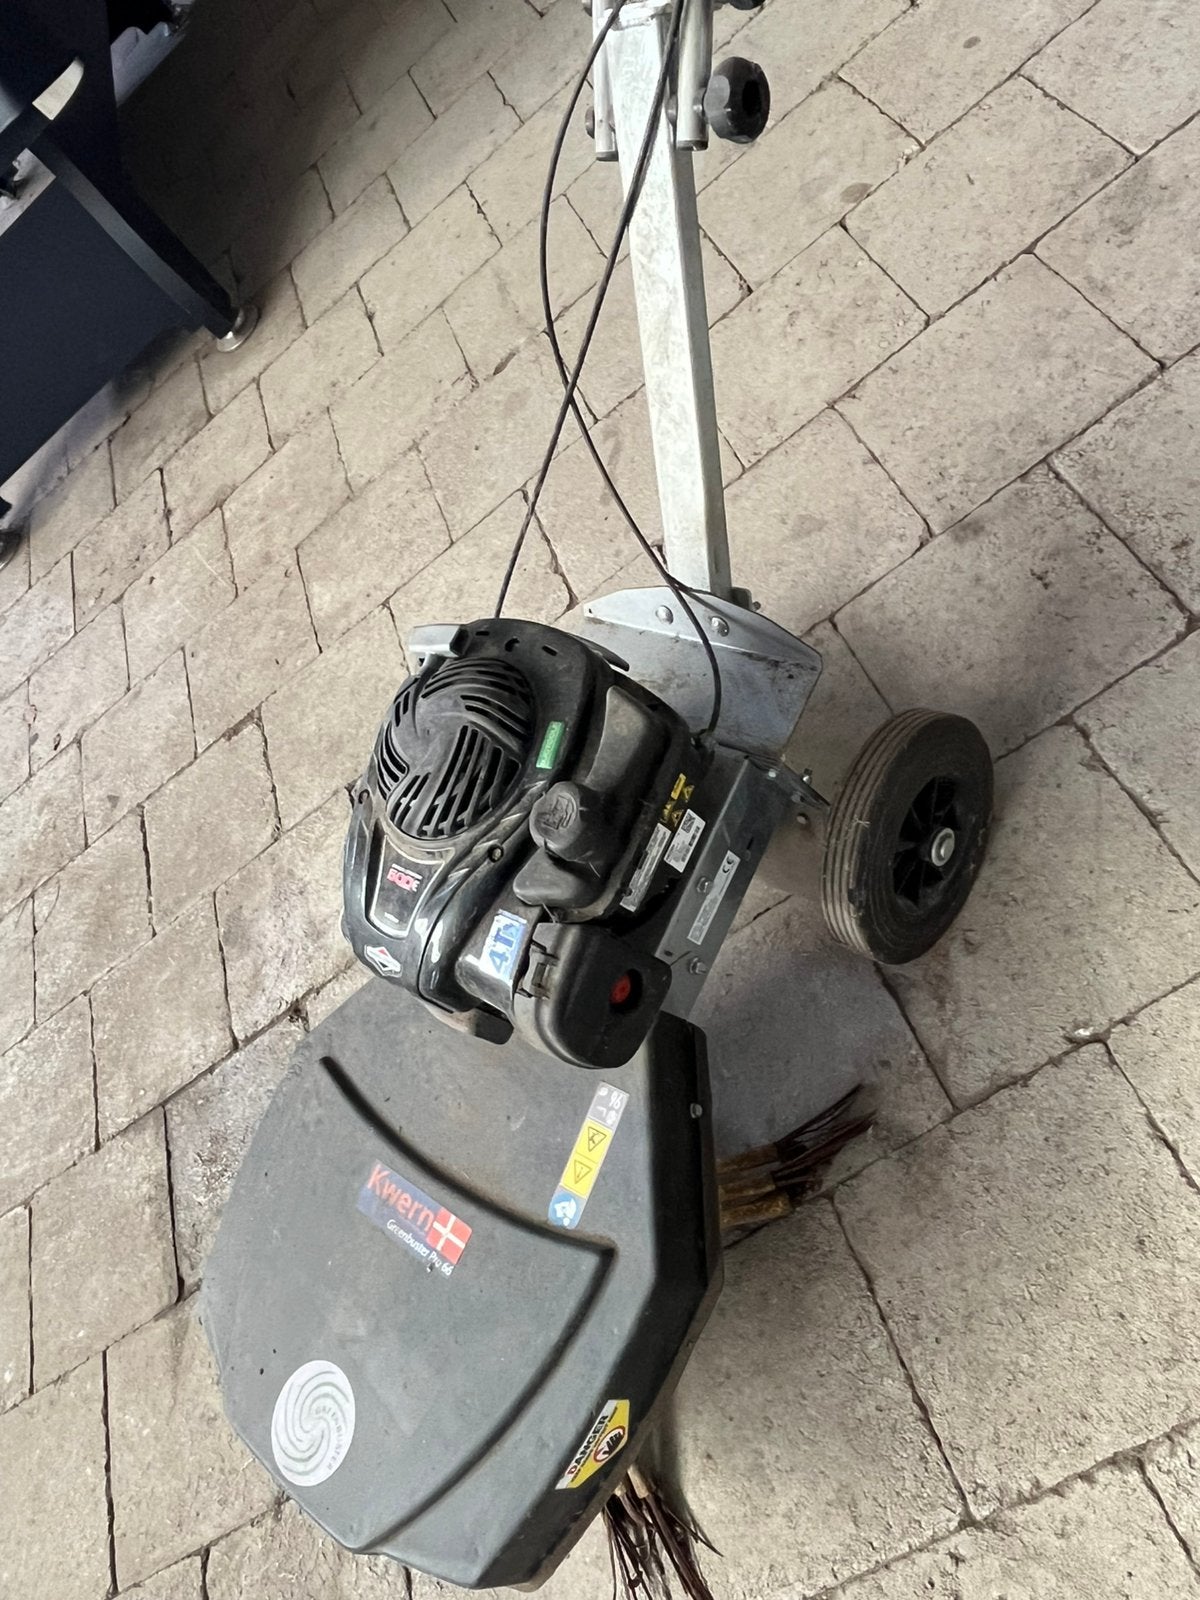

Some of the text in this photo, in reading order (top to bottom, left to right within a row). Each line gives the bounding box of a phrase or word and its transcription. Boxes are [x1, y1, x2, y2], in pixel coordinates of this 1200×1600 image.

[367, 1163, 434, 1232] Kwern
[386, 1218, 455, 1276] Greenbuster Pro 66
[566, 1414, 609, 1475] DANGER
